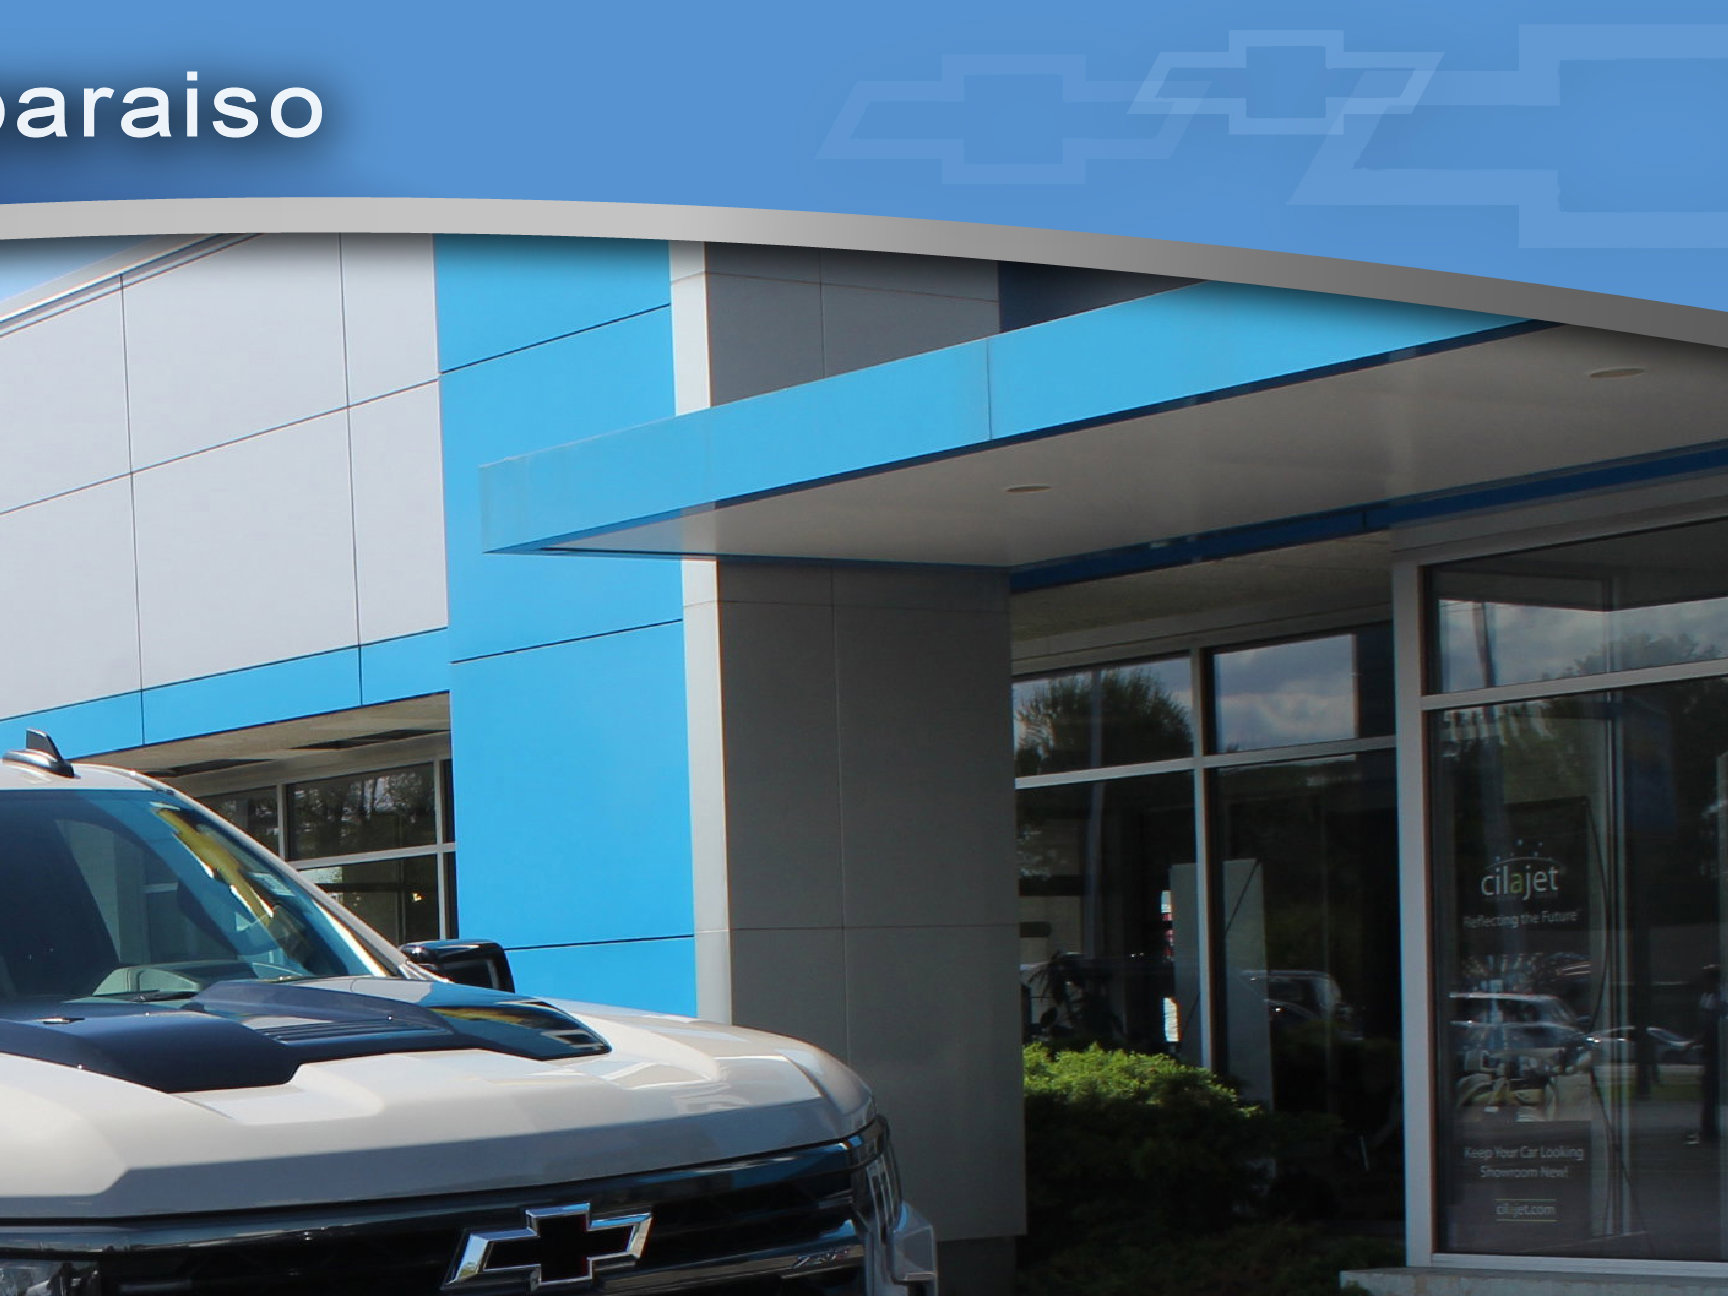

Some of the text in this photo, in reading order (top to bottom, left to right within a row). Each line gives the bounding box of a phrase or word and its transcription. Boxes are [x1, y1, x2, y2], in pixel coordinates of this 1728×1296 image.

[1480, 864, 1560, 901] cilajet
[1540, 909, 1577, 923] Future
[1463, 1144, 1585, 1161] Keep Your Car Looking
